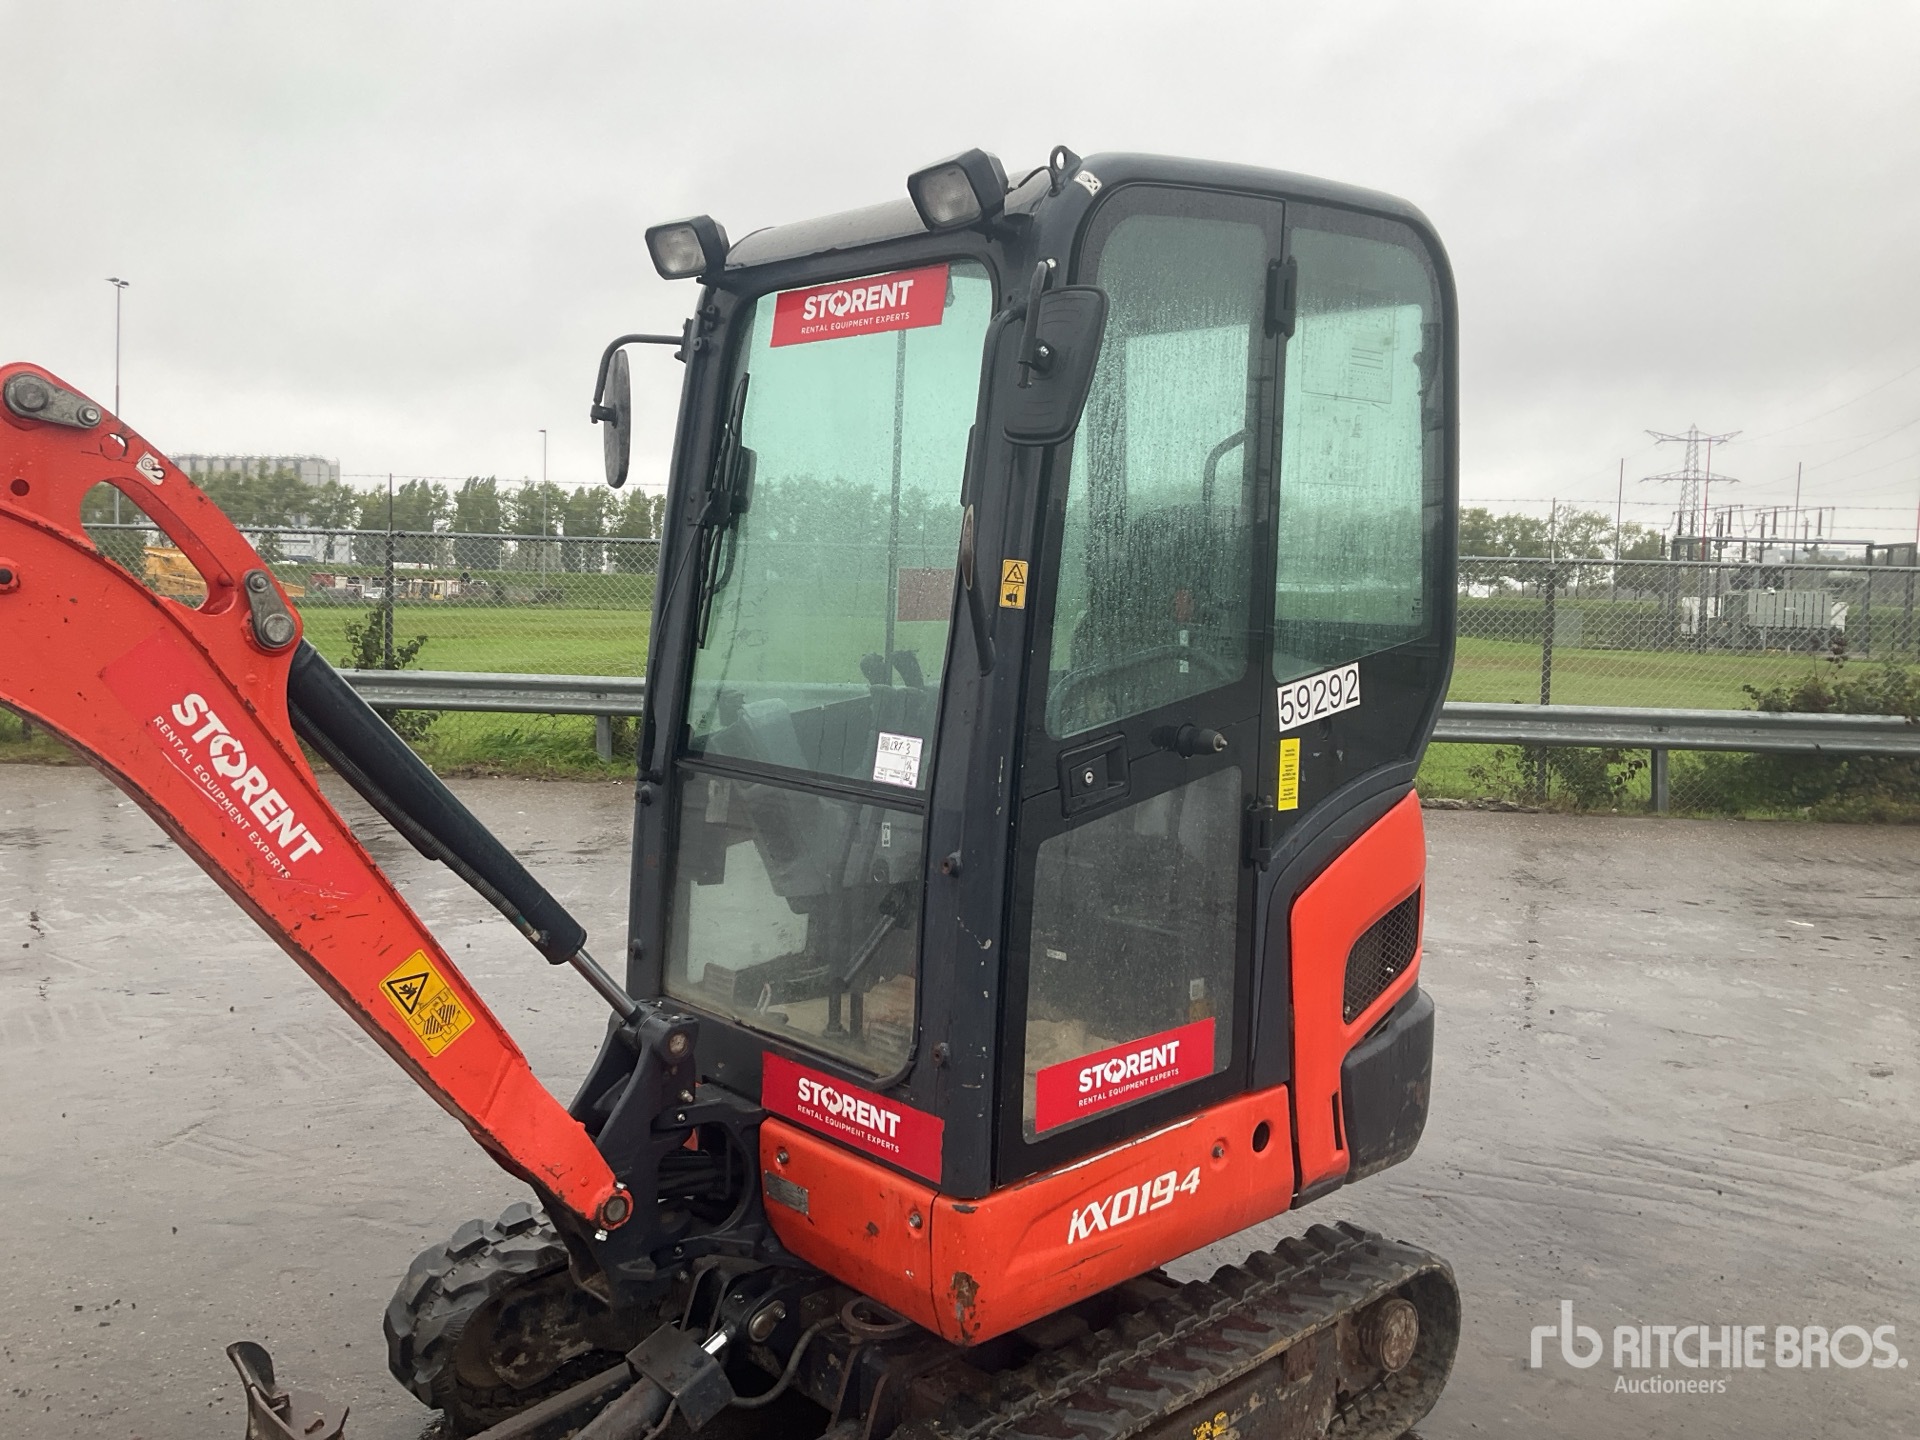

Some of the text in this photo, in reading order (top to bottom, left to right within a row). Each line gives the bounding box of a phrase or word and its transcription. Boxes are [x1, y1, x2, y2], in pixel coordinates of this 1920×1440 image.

[801, 312, 910, 334] RENTAL EQUIPMENT EXPERTS
[802, 279, 914, 321] STORENT
[1280, 669, 1358, 725] 59292
[153, 715, 291, 879] RENTAL EQUIPMENT EXPERTS
[171, 693, 323, 862] STORENT
[1078, 1040, 1180, 1093] STORENT
[1078, 1068, 1179, 1107] RENTAL EQUIPMENT EXPERTS
[797, 1077, 901, 1138] STORENT
[797, 1104, 900, 1153] RENTAL EQUIPMENT EXPERTS
[1067, 1166, 1201, 1245] KX019-4
